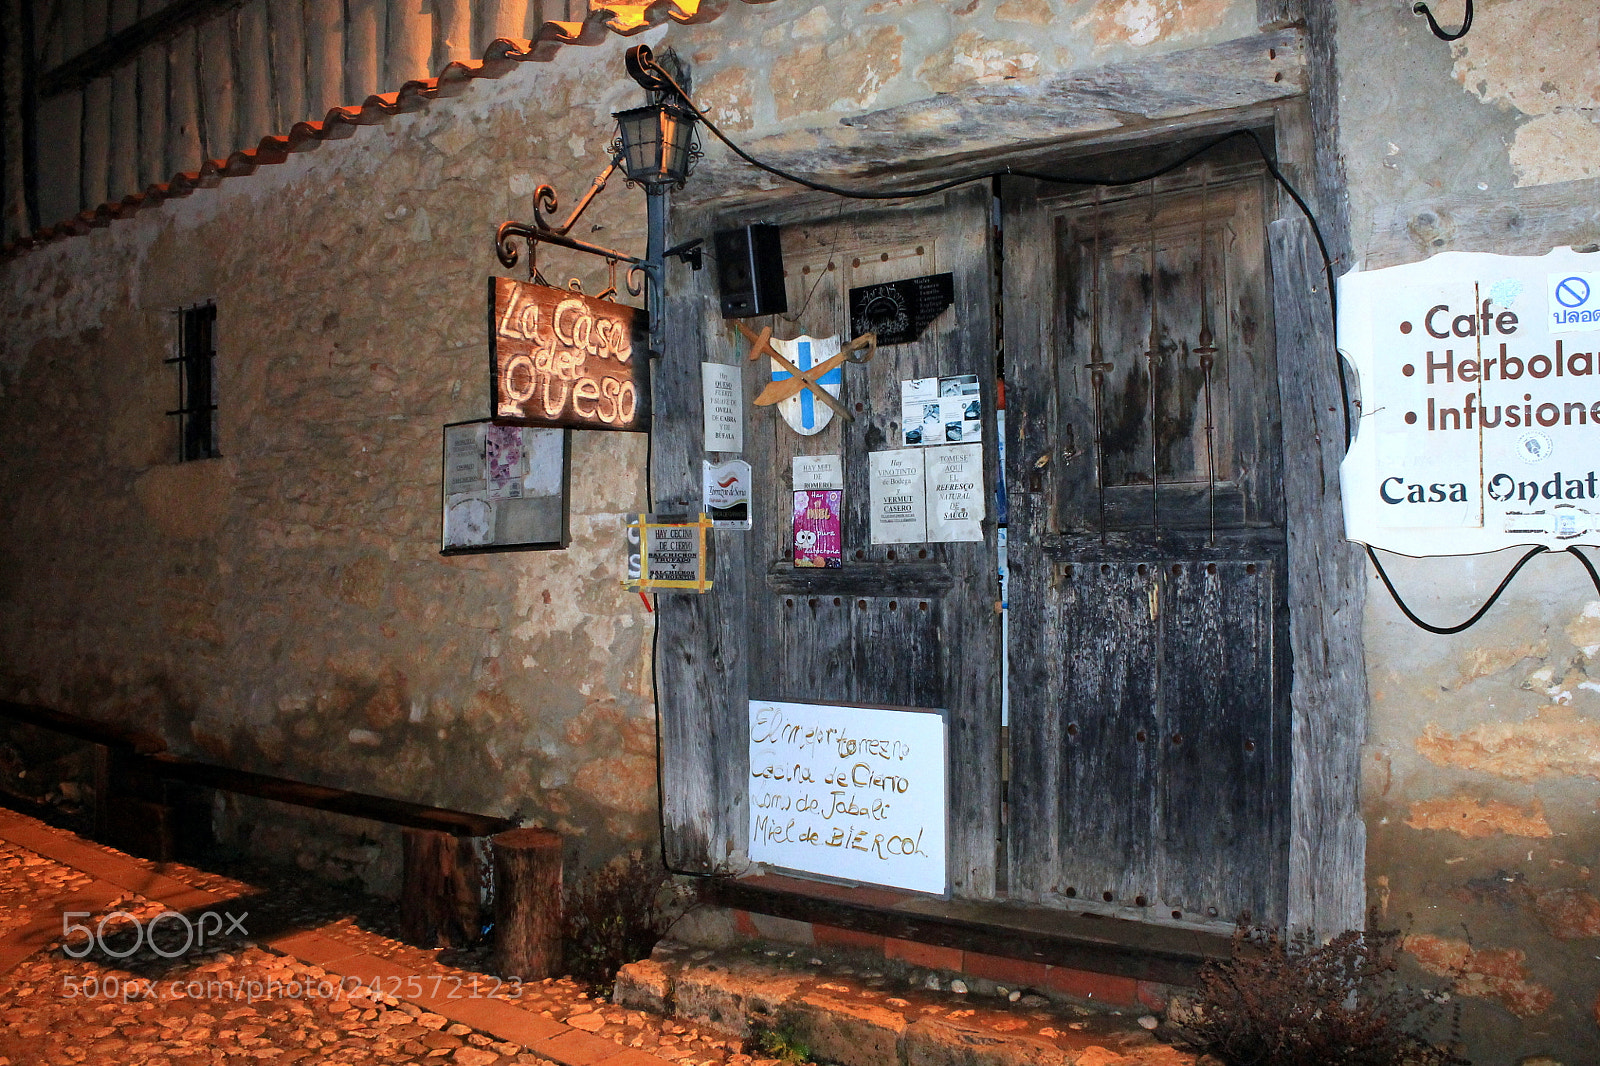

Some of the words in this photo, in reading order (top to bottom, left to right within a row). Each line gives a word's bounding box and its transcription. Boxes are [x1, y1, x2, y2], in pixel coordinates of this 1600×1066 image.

[500, 281, 546, 346] La
[553, 299, 633, 362] Casa
[1425, 298, 1519, 339] Cafe
[1426, 339, 1600, 384] Herbola
[715, 381, 733, 390] QUESO
[803, 464, 816, 472] HAY
[878, 469, 894, 477] VINO
[804, 482, 833, 490] ROMERO
[890, 478, 911, 486] Bodega
[1380, 476, 1468, 504] Casa
[811, 491, 824, 500] Hay
[950, 502, 960, 510] DE
[655, 529, 667, 538] HAY
[670, 529, 692, 538] CECINA
[659, 541, 667, 550] DE
[670, 541, 692, 550] CIERVO
[751, 707, 782, 743] El
[825, 767, 848, 787] de
[796, 793, 820, 815] de
[754, 815, 795, 846] Miel
[799, 827, 823, 846] de
